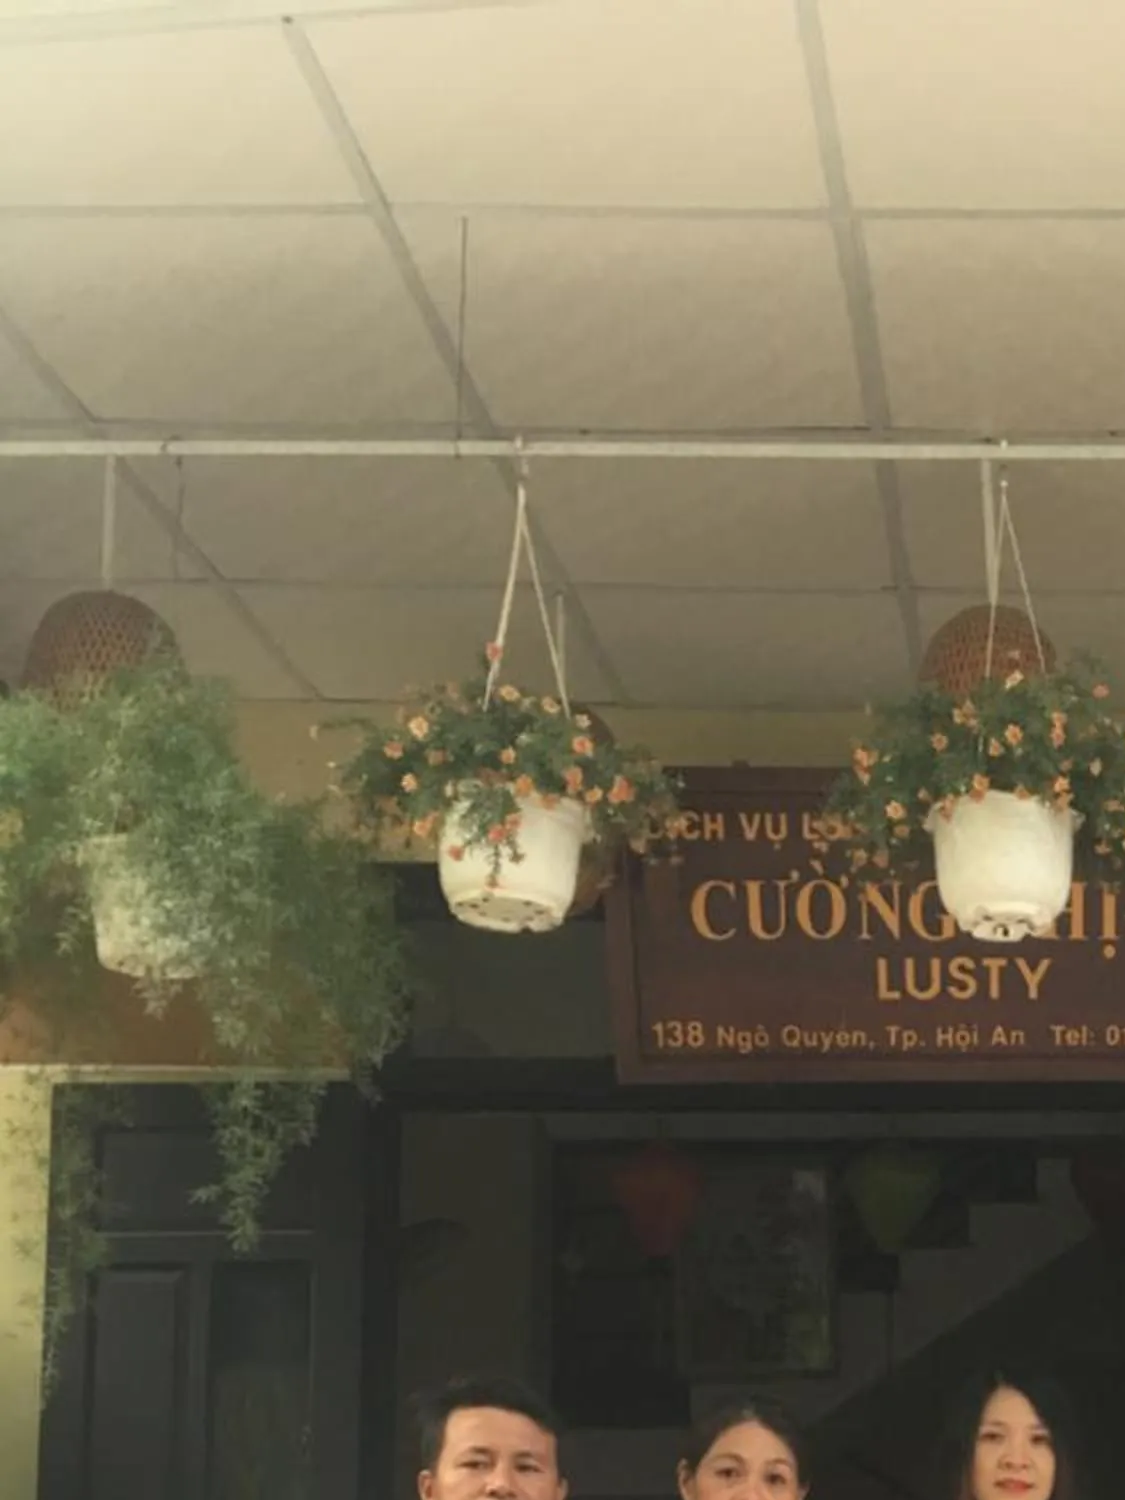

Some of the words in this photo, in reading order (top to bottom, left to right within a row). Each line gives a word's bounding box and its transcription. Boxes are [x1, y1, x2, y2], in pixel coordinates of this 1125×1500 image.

[876, 956, 1052, 1000] LUSTY
[652, 1020, 705, 1049] 138
[884, 1025, 926, 1052] Tp.
[991, 1025, 1025, 1047] An
